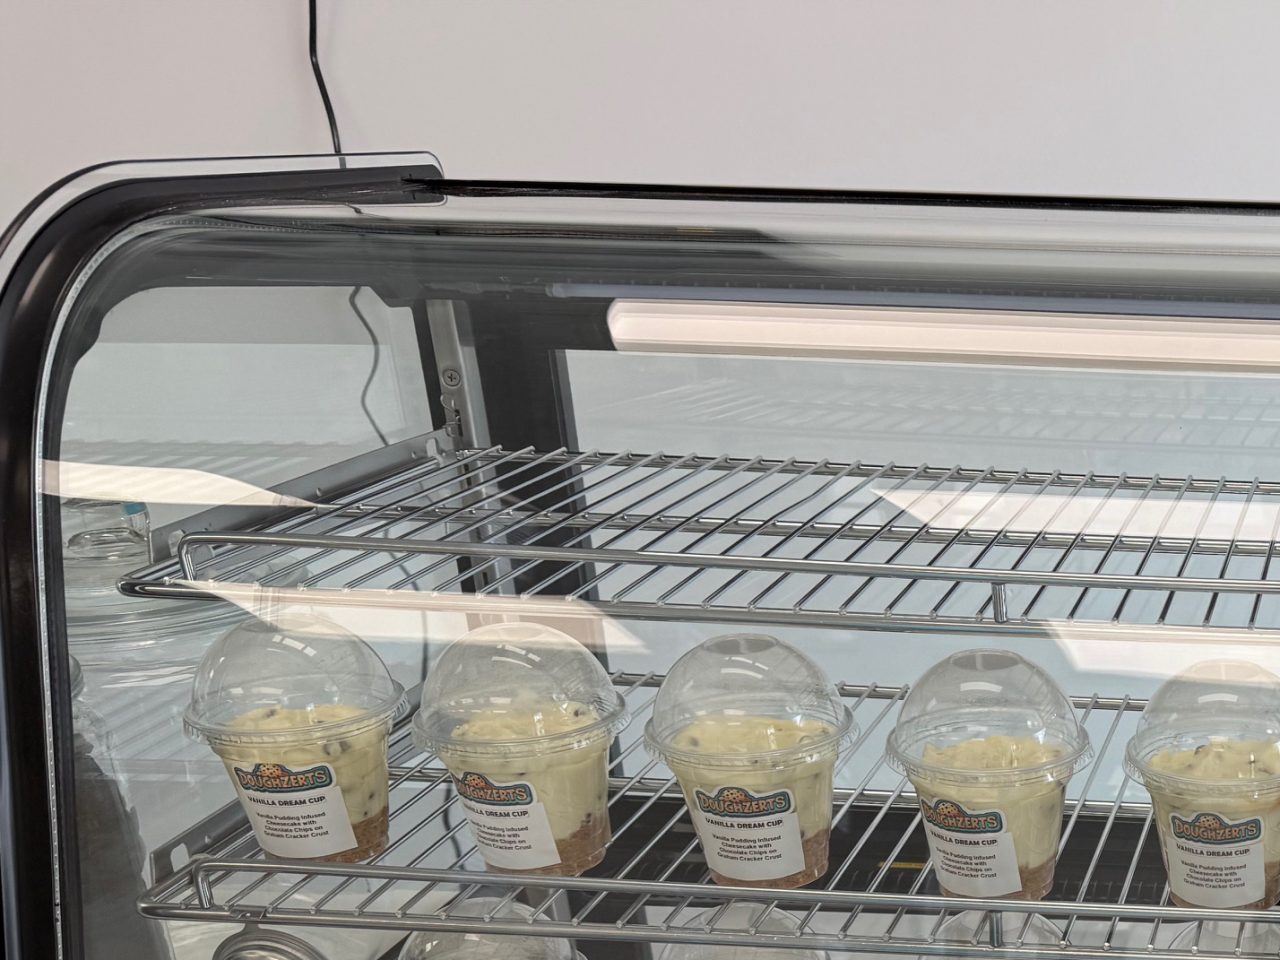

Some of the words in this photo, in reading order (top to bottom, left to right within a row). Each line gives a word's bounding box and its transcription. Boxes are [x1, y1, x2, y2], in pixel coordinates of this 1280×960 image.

[239, 770, 327, 789] DOUGHZERTS
[247, 796, 276, 806] VANILLA
[308, 795, 326, 804] CUP
[699, 793, 786, 814] DOUGHZERTS
[705, 818, 735, 828] VANILLA
[766, 819, 783, 827] CUP
[1174, 819, 1257, 840] DOUGHZERTS
[1176, 843, 1205, 856] VANILLA
[1234, 848, 1250, 856] CUP
